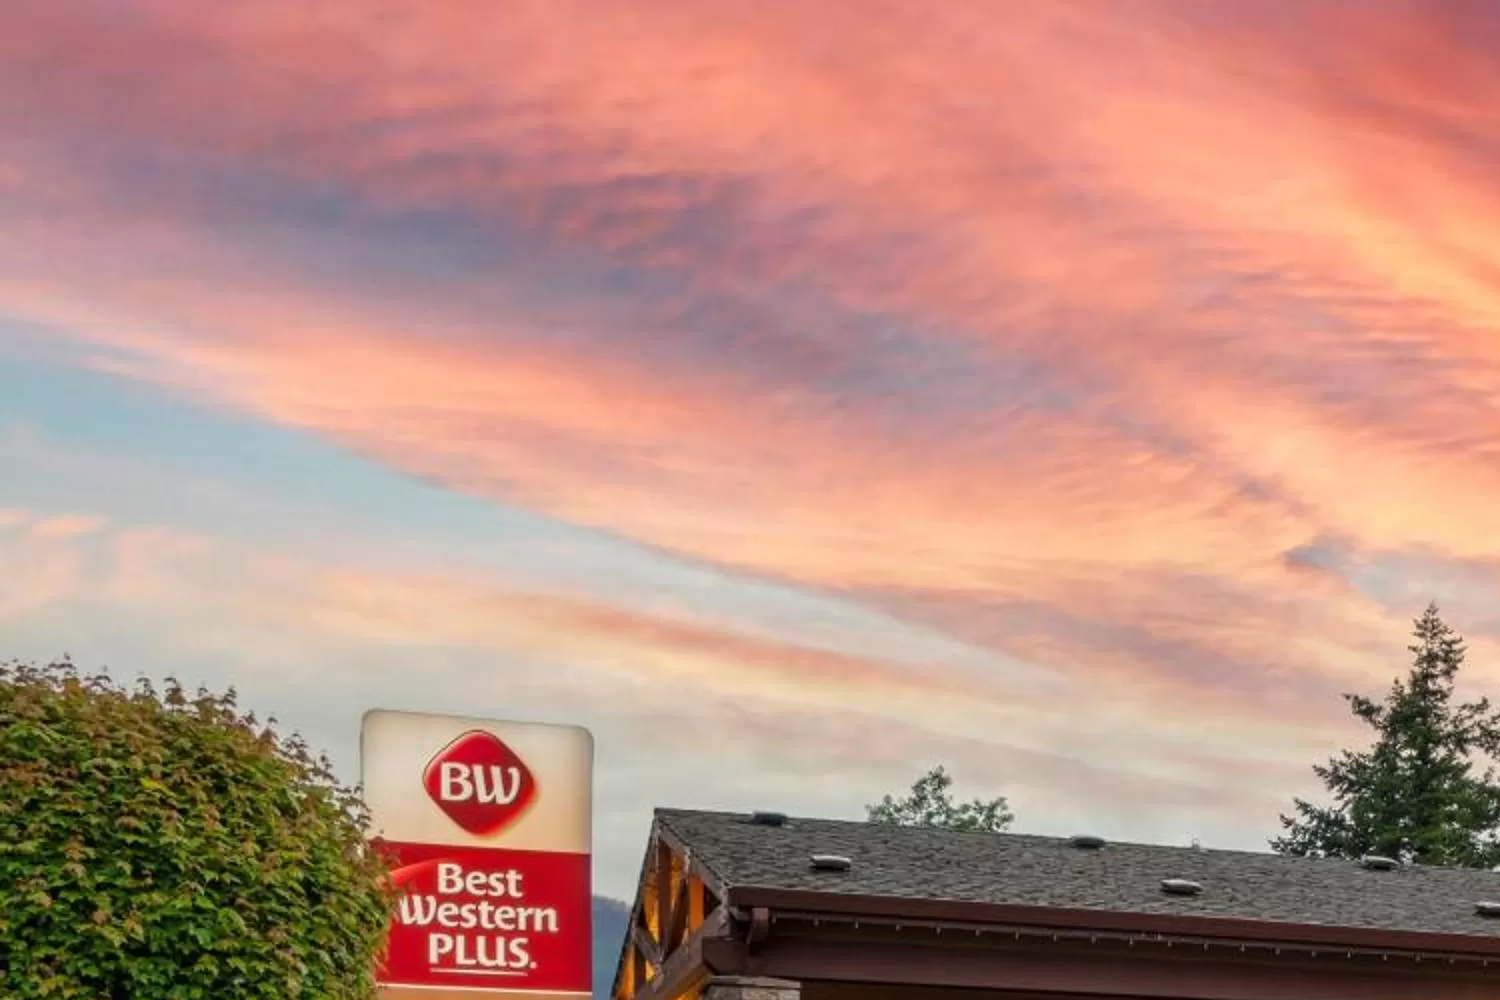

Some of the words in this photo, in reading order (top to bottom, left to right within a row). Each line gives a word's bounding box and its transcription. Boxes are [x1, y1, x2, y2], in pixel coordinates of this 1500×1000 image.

[439, 762, 521, 805] BW
[437, 863, 524, 898] Best
[399, 894, 560, 932] Western
